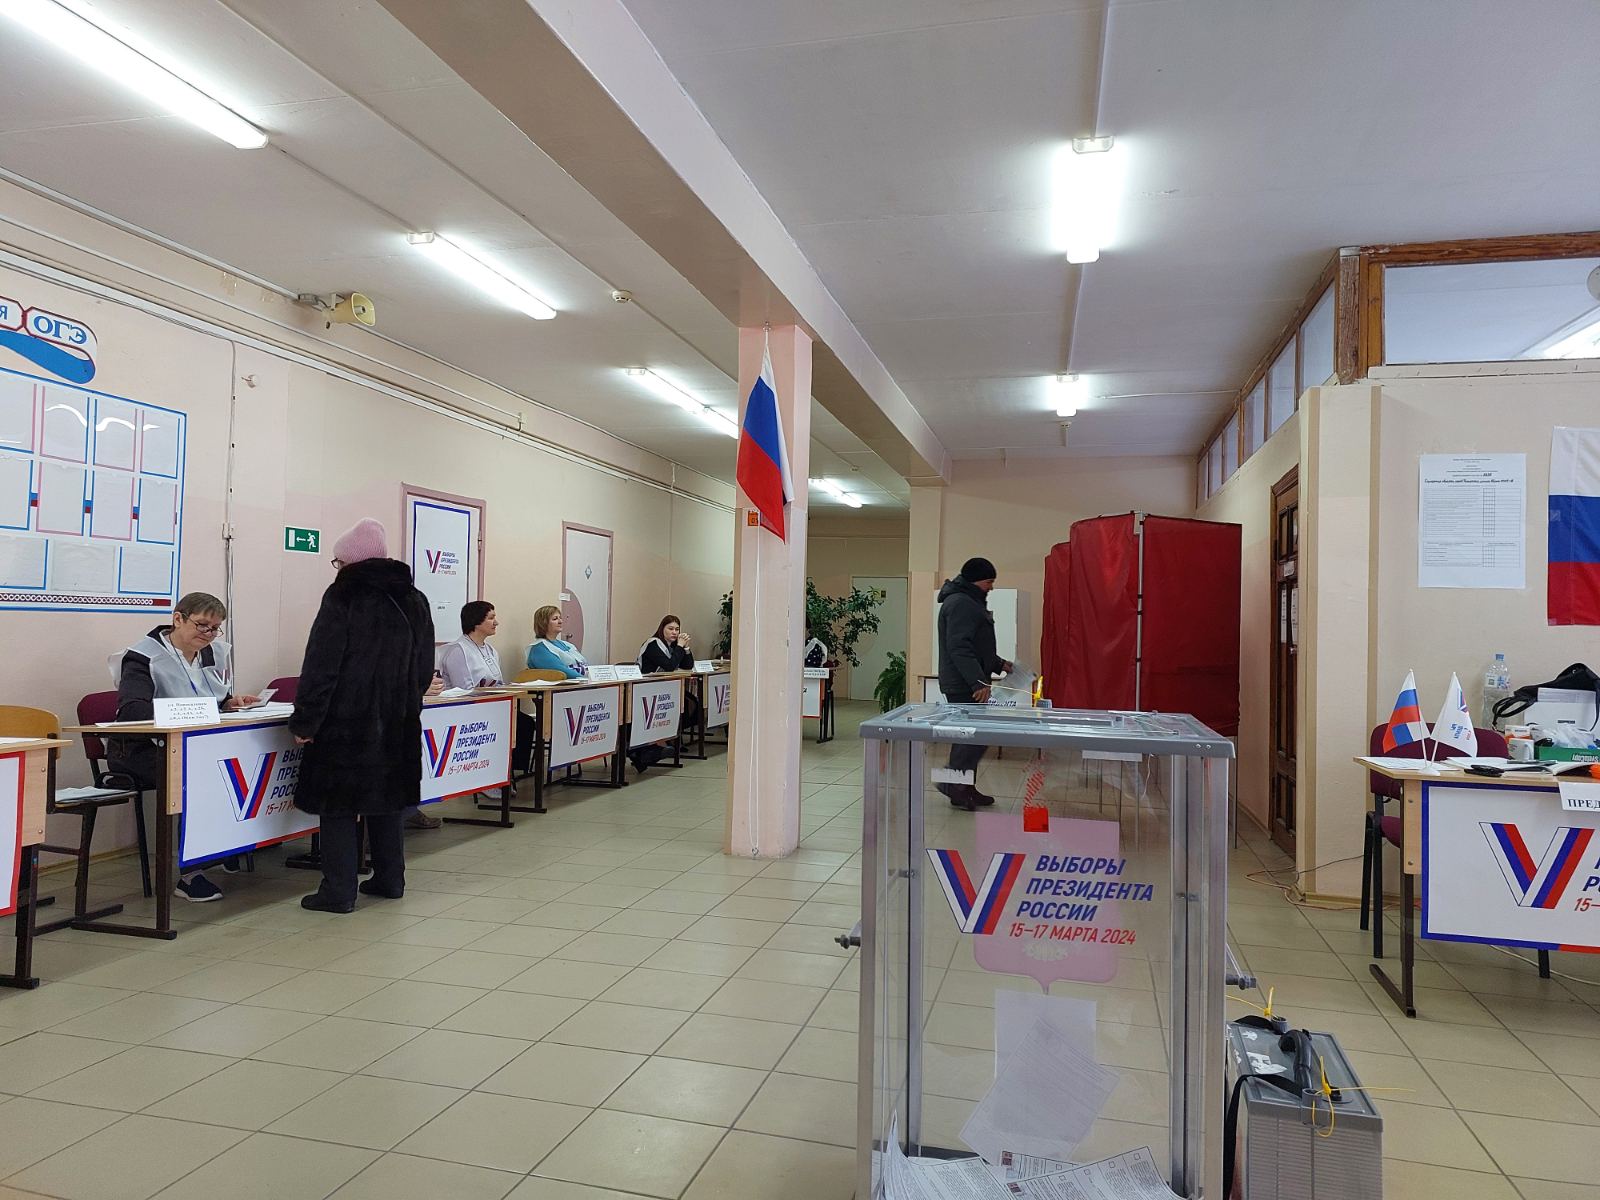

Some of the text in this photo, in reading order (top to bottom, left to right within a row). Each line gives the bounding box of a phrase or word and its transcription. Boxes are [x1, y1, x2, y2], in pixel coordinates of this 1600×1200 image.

[33, 315, 88, 345] ОГЭ
[459, 721, 489, 735] ВЫБОРЫ
[455, 733, 497, 749] ПРЕЗИДЕНТА
[452, 749, 480, 763] РОССИИ
[1035, 854, 1127, 876] ВЫБОРЫ
[1025, 878, 1155, 902] ПРЕЗИДЕНТА
[1016, 900, 1099, 922] РОССИИ
[1049, 925, 1099, 943] МАРТА
[1100, 928, 1137, 945] 2024
